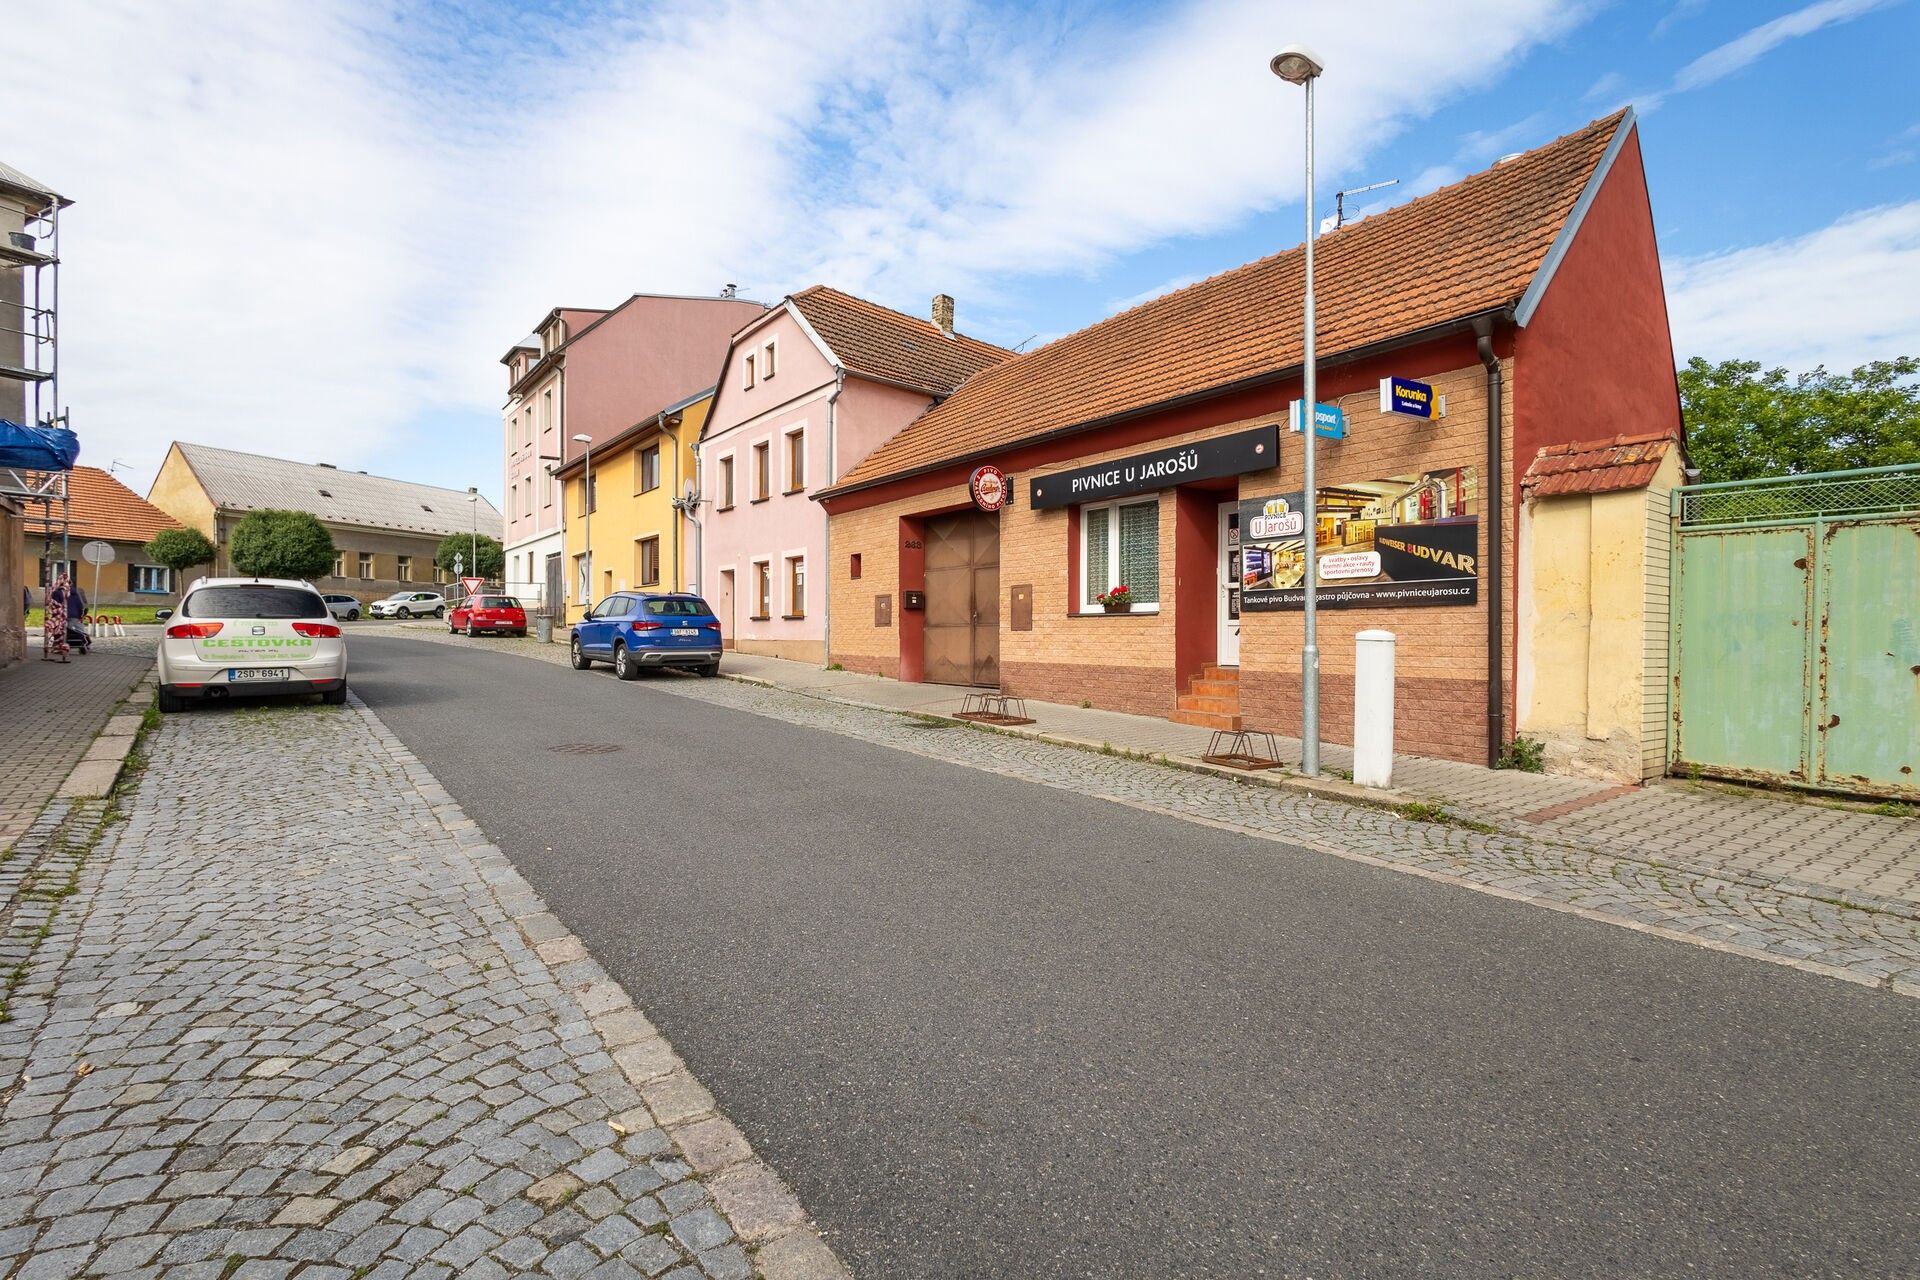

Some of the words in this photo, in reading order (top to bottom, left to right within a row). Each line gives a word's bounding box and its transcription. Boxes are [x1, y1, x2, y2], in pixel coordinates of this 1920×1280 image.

[1395, 385, 1427, 403] Korunka
[1315, 411, 1336, 424] psport
[1072, 470, 1120, 493] PIVNICE
[1125, 467, 1135, 482] U
[1140, 449, 1198, 480] JAROŠŮ
[1265, 512, 1287, 521] PIVNICE
[1254, 520, 1262, 535] U
[1263, 517, 1297, 536] Jarošů
[1407, 543, 1477, 576] BUDVAR
[1243, 595, 1268, 604] Tankové
[1269, 596, 1283, 604] pivo
[1336, 592, 1370, 602] půjčovna
[1375, 588, 1471, 599] www.pivniceujarosu.cz
[203, 638, 312, 648] CESTOVKA
[237, 670, 255, 678] 2SD
[261, 669, 285, 678] 6941
